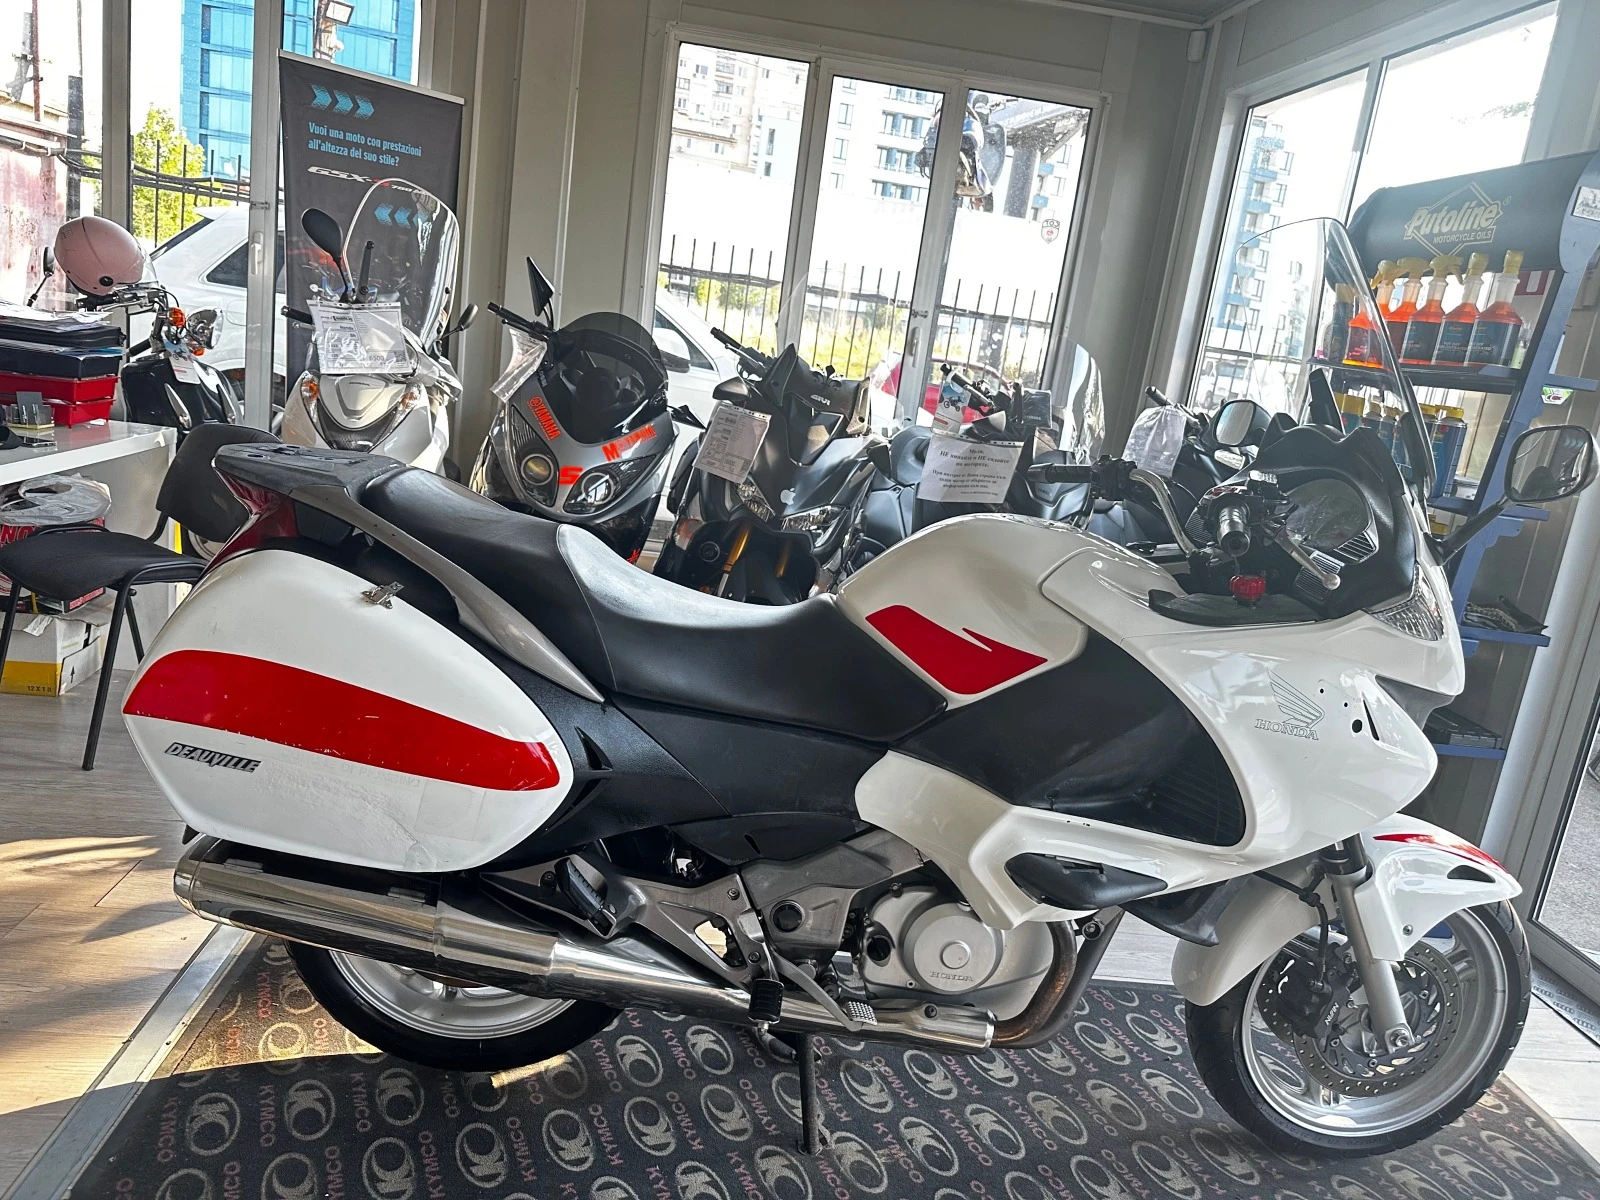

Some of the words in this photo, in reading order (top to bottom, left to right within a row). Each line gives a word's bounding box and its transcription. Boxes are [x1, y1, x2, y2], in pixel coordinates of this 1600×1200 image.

[308, 139, 348, 156] all'altezza
[350, 147, 361, 159] del
[364, 151, 377, 162] suo
[379, 153, 399, 166] stile?
[309, 122, 327, 135] Vuoi
[329, 129, 343, 139] una
[346, 132, 364, 144] moto
[367, 136, 380, 147] con
[383, 139, 421, 156] prestazioni
[1404, 200, 1501, 237] Putoline
[1433, 231, 1476, 244] MOTORCYCLE
[1476, 230, 1492, 241] OILS
[534, 403, 561, 440] YAMAHA
[1255, 718, 1319, 740] HONDA
[166, 742, 261, 774] DEAUVILLE
[930, 972, 974, 982] HONDA
[590, 1038, 623, 1092] KYMCO
[662, 1028, 696, 1080] KYMCO
[1057, 1034, 1098, 1072] KYMC
[1100, 1018, 1152, 1062] KYMCO
[872, 1056, 919, 1109] KYMCO
[942, 1056, 982, 1095] KYMC
[1119, 1073, 1177, 1123] KYMCO
[260, 1085, 276, 1147] KYMCO
[350, 1072, 372, 1132] KYMCO
[666, 1091, 705, 1151] KYMCO
[739, 1078, 780, 1136] KYMCO
[1003, 1096, 1058, 1150] KYMCO
[1064, 1084, 1119, 1136] KYMCO
[158, 1097, 176, 1162] KYMCO
[506, 1116, 537, 1182] KYMCO
[588, 1103, 624, 1166] KYMCO
[873, 1122, 924, 1184] KYMCO
[939, 1108, 993, 1166] KYMCO
[324, 1146, 344, 1200] YMCO
[418, 1130, 446, 1199] KYMCO
[726, 1151, 764, 1200] KYMC
[1102, 1149, 1150, 1200] YMCO
[1161, 1136, 1227, 1195] KYMCO
[1459, 1136, 1539, 1192] KYMCO
